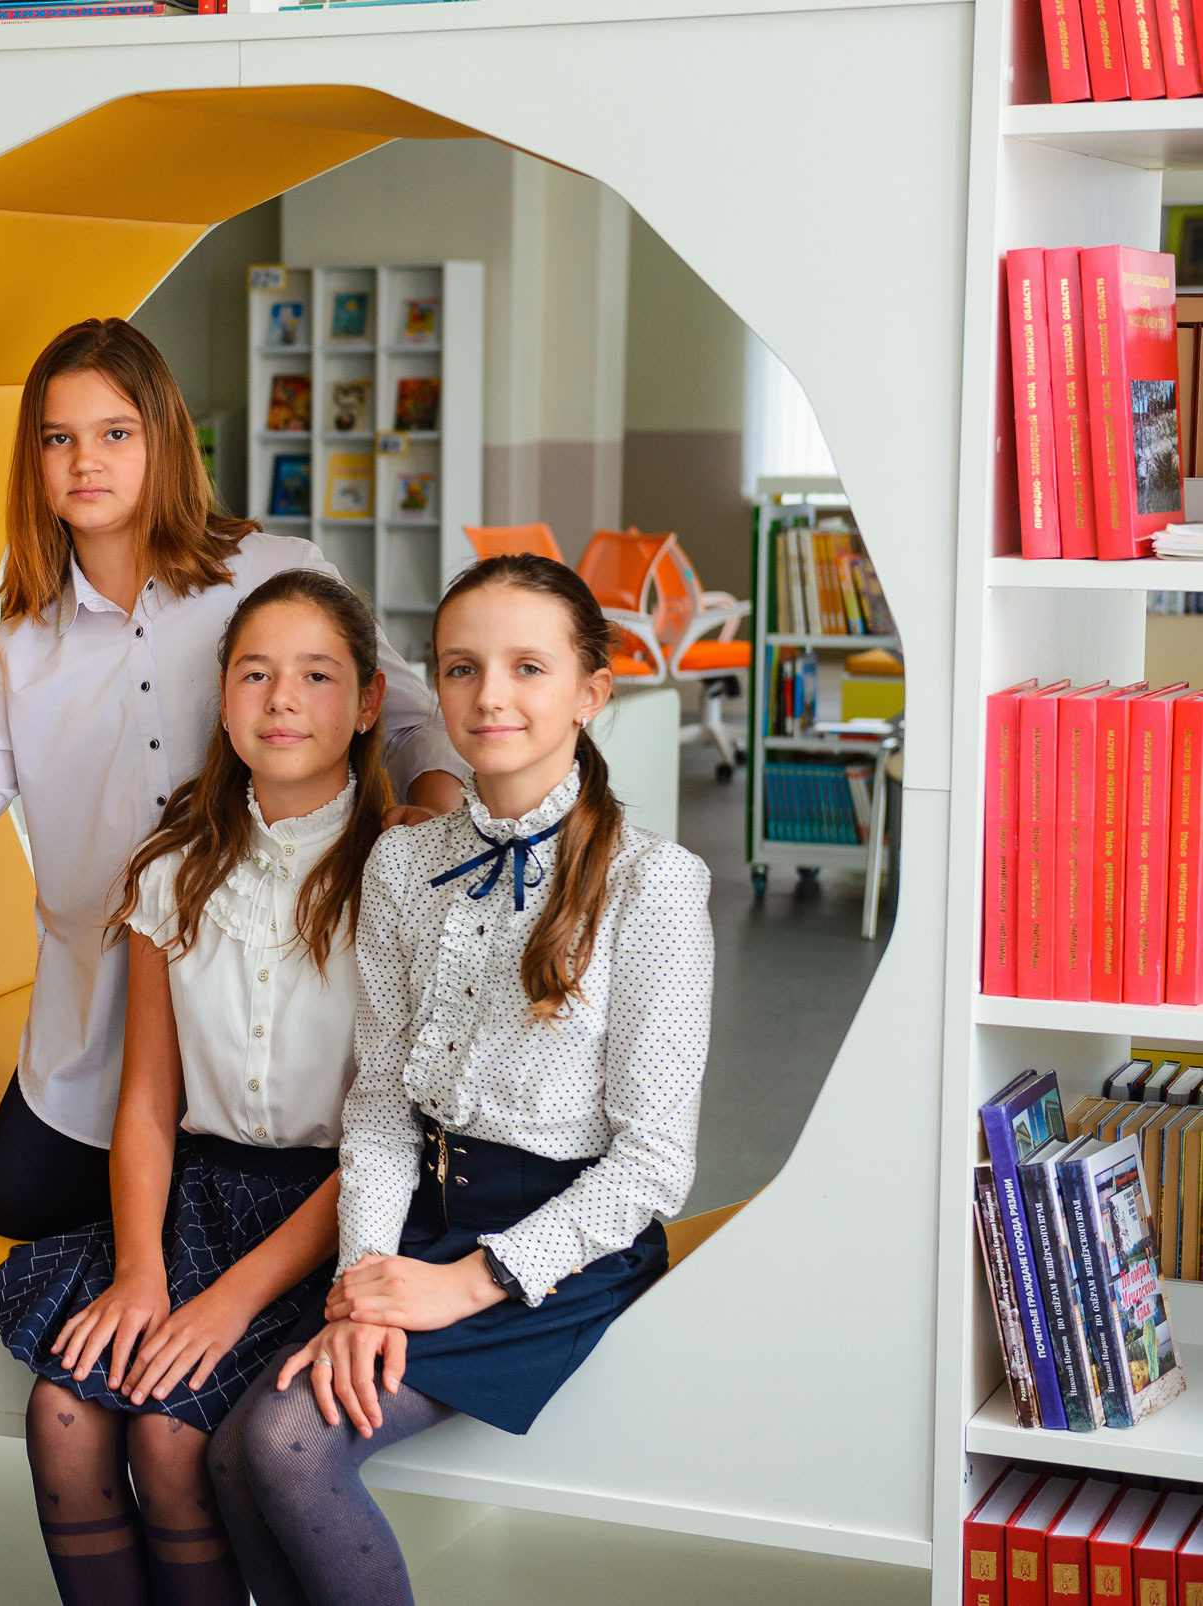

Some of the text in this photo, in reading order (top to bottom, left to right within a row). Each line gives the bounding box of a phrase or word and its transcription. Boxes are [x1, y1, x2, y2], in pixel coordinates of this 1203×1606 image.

[12, 5, 155, 19] ПЛАСТИЧЕСКИЕ
[1061, 278, 1071, 320] ОБЛАСТИ
[1097, 278, 1107, 320] ОБЛАСТИ
[1064, 323, 1075, 376] РЯЗАНСКОЙ
[1022, 279, 1043, 529] ПРИРОДНО- ЗАПОВЕДНЫЙ ФОНД РЯЗАНСКОЙ ОБЛАСТИ
[1068, 381, 1076, 409] ФОНД
[1145, 730, 1153, 771] ОБЛАСТИ
[1184, 730, 1192, 770] ОБЛАСТИ
[1143, 775, 1153, 826] РЯЗАНСКОЙ
[1182, 774, 1191, 825] РЯЗАНСКОЙ
[1105, 730, 1116, 975] ПРИРОДНО- ЗАПОВЕДНЫЙ ФОНД РЯЗАНСКОЙ ОБЛАСТИ
[1141, 832, 1150, 858] ФОНД
[1180, 831, 1189, 858] ФОНД
[1140, 864, 1148, 924] ЗАПОВЕДНЫЙ
[1178, 862, 1188, 923] ЗАПОВЕДНЫЙ
[1003, 1178, 1047, 1359] ПОЧЕТНЫЕ ГРАЖДАНЕ ГОРОДА РЯЗАНИ
[1120, 1270, 1131, 1290] По
[1035, 1202, 1078, 1397] Николай Нырков ПО ОЗЁРАМ МЕЩЁРСКОГО КРАЯ
[1073, 1200, 1115, 1393] Николай Нырков ПО ОЗЁРАМ МЕЩЁРСКОГО КРАЯ
[1135, 1302, 1151, 1324] края
